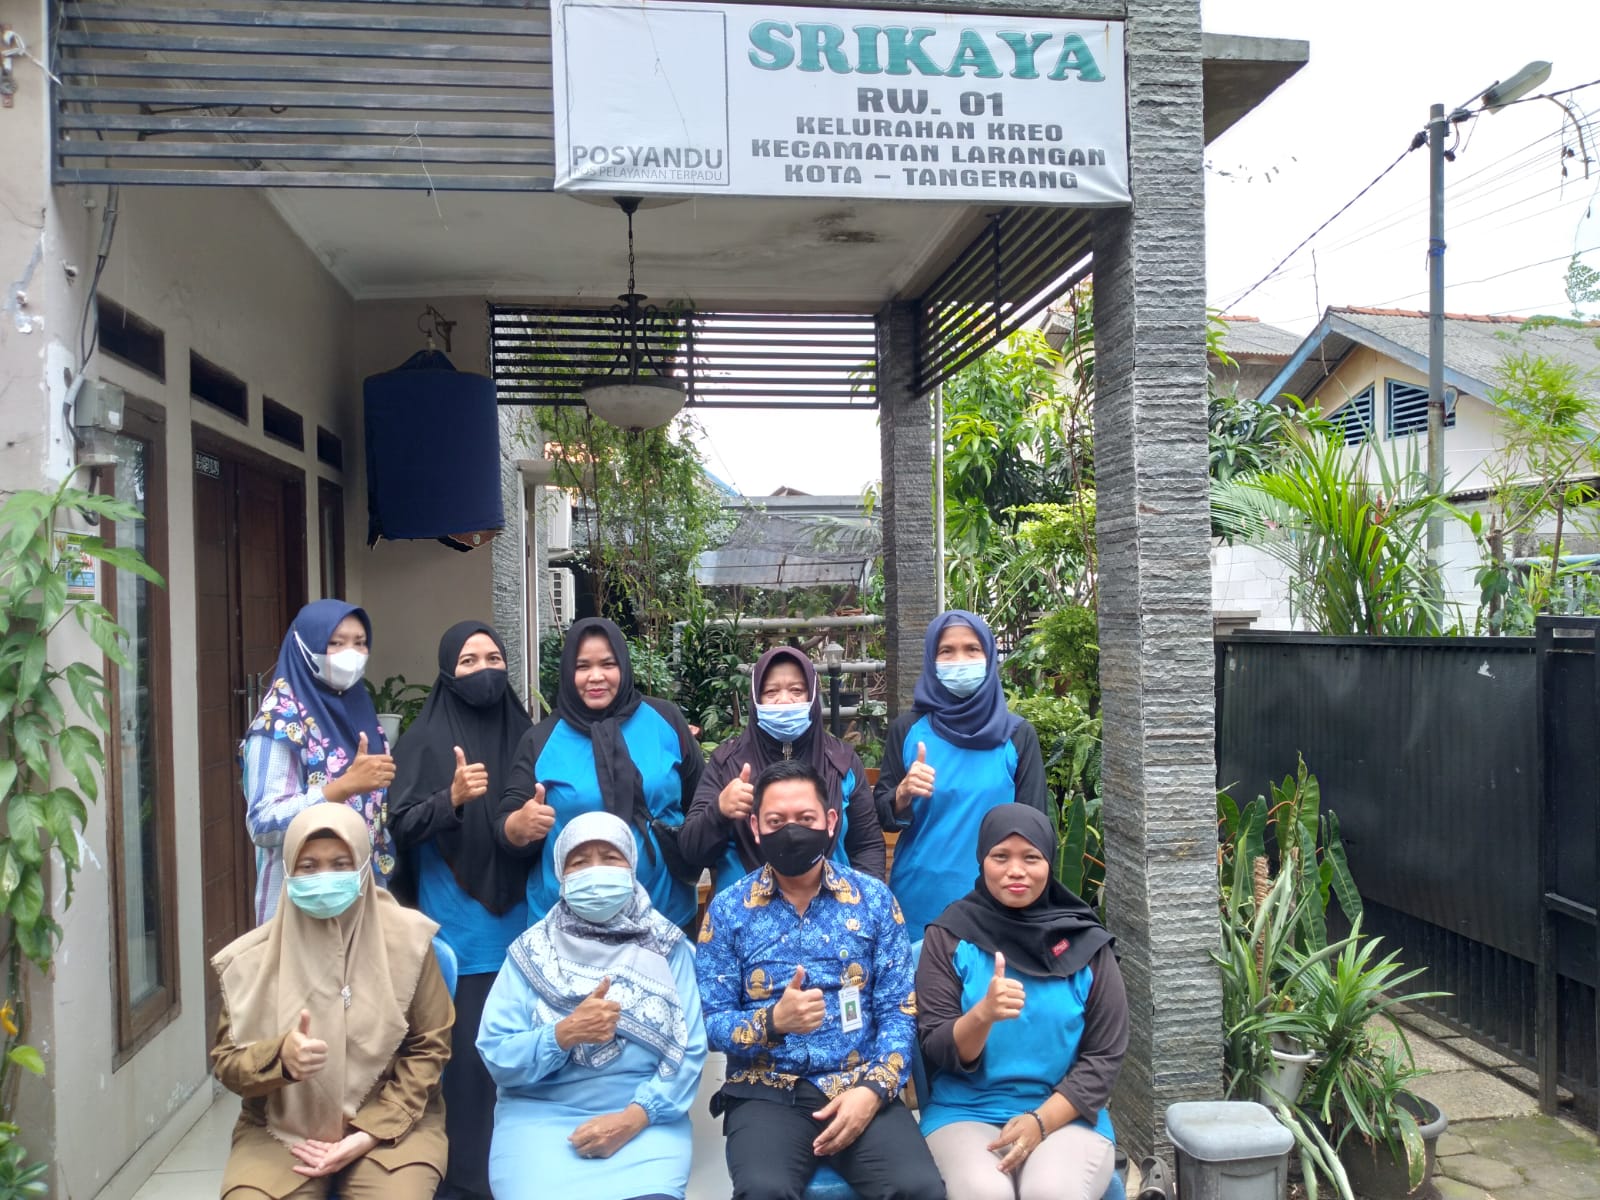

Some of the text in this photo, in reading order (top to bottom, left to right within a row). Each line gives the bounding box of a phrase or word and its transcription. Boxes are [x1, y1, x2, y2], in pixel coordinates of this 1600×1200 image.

[748, 21, 1106, 82] SRIKAYA
[857, 87, 1004, 117] RW. 01
[796, 116, 1063, 142] KELURAHAN KREO
[572, 145, 723, 169] POSYANDU
[751, 139, 1106, 166] KECAMATAN LARANGAN
[599, 167, 667, 180] PELAYANAN
[671, 169, 722, 181] TERPADU
[785, 164, 862, 184] KOTA
[902, 168, 1078, 189] TANGERANG
